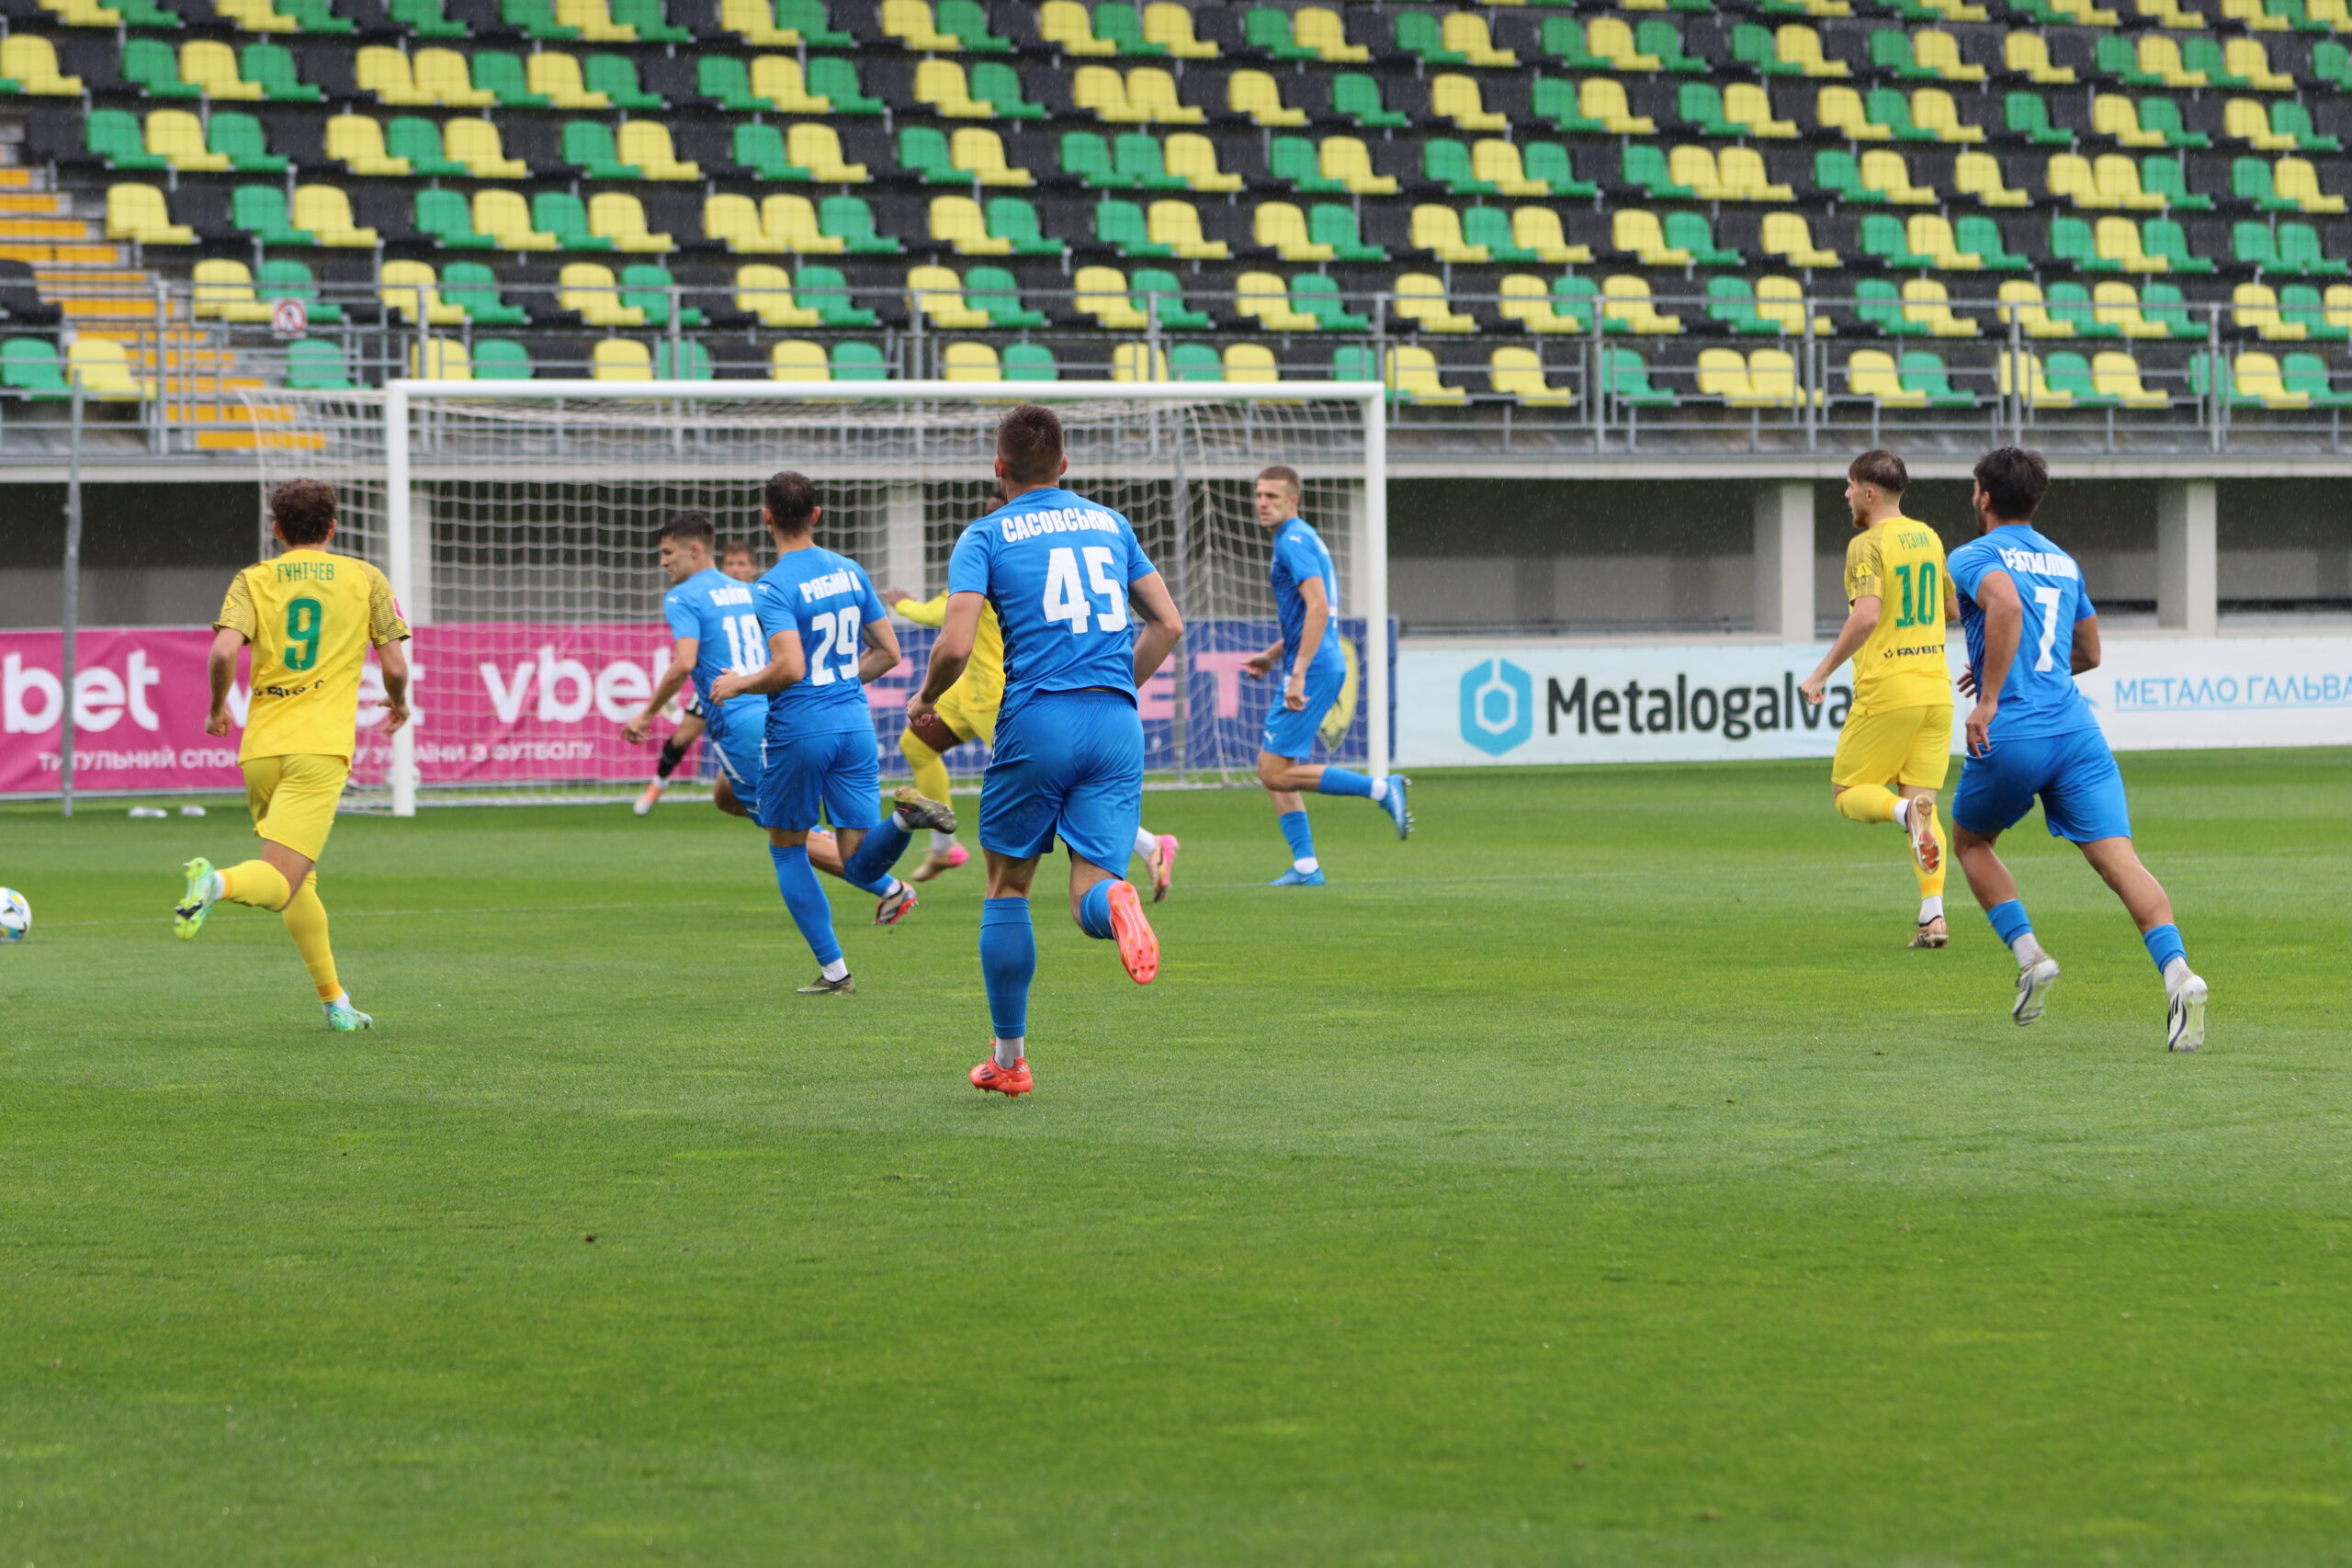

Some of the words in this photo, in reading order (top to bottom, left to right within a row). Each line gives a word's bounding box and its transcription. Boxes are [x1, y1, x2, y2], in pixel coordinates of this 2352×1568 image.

[1001, 507, 1120, 543] САСОВСЬКИЙ
[277, 561, 334, 583] ГУНІЧЕВ
[1043, 546, 1127, 635] 45
[1894, 560, 1936, 628] 10
[284, 597, 323, 671] 9
[722, 614, 767, 678] 18
[810, 604, 862, 687] 29
[1896, 644, 1945, 657] FAVBET
[2034, 586, 2062, 672] 7
[1547, 671, 1853, 741] Metalogalva
[2115, 676, 2239, 705] МЕТАЛО
